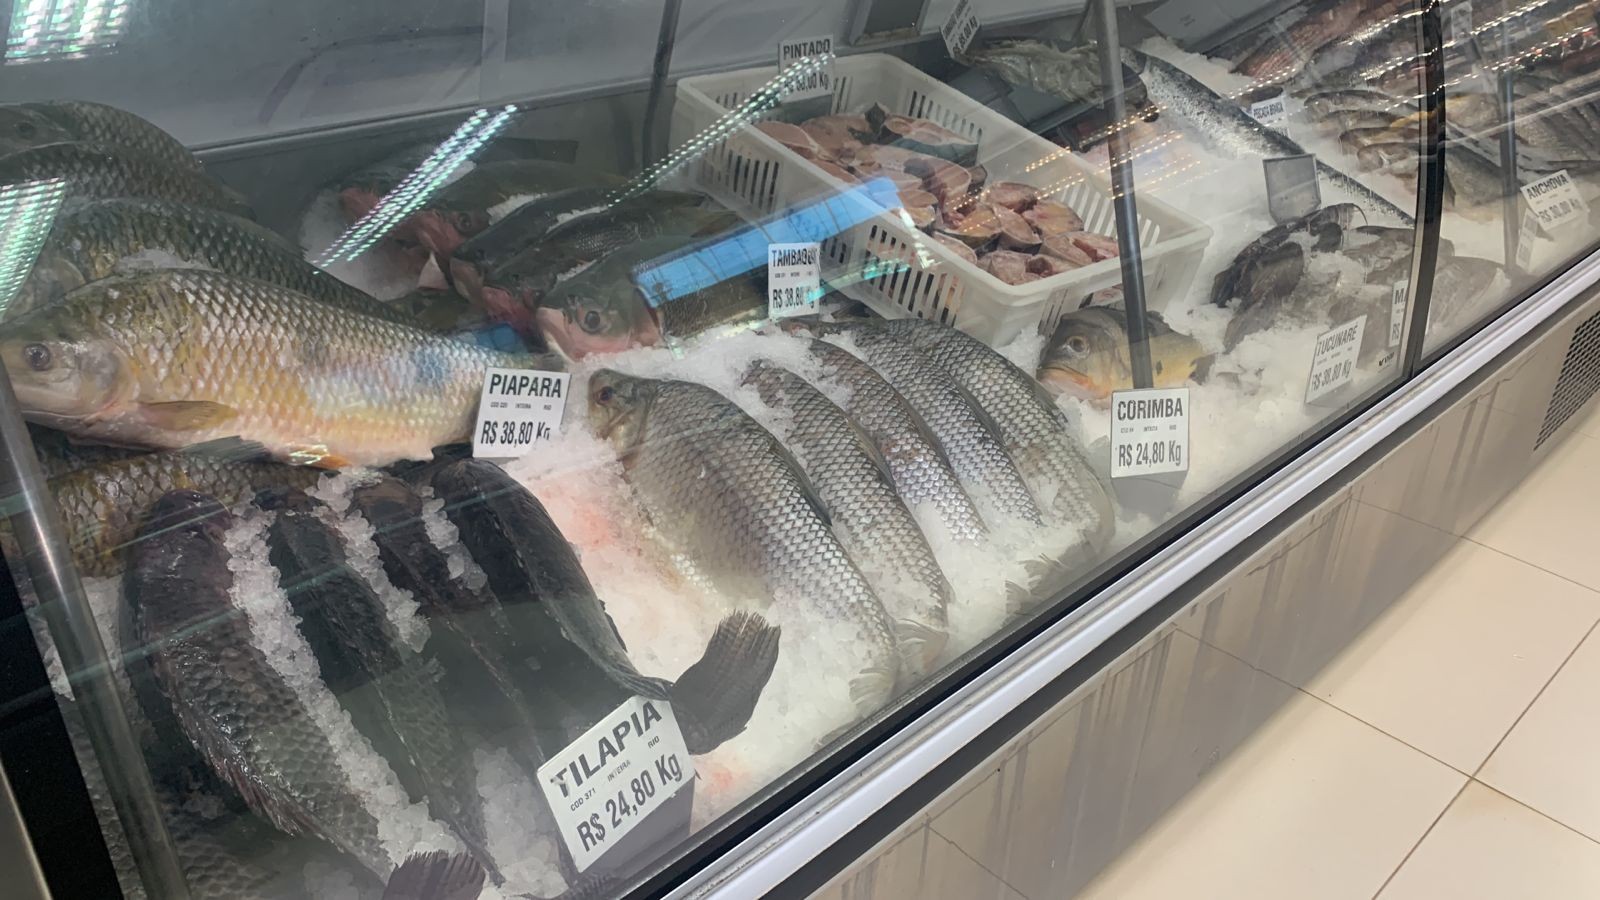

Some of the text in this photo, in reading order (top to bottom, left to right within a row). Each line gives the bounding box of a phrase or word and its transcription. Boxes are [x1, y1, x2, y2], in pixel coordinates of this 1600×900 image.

[783, 38, 831, 60] PINTADO
[1526, 173, 1569, 200] ANCHOVA
[489, 373, 561, 398] PIAPARA
[1117, 397, 1183, 421] CORIMBA
[480, 420, 498, 447] R$
[500, 420, 534, 448] 38,80
[1118, 440, 1182, 468] R$ 24,80 Kg
[550, 700, 662, 798] TILAPIA
[570, 797, 584, 812] COD
[585, 787, 597, 801] 371
[647, 735, 660, 749] RIO
[576, 753, 683, 852] R$ 24,80 Kg
